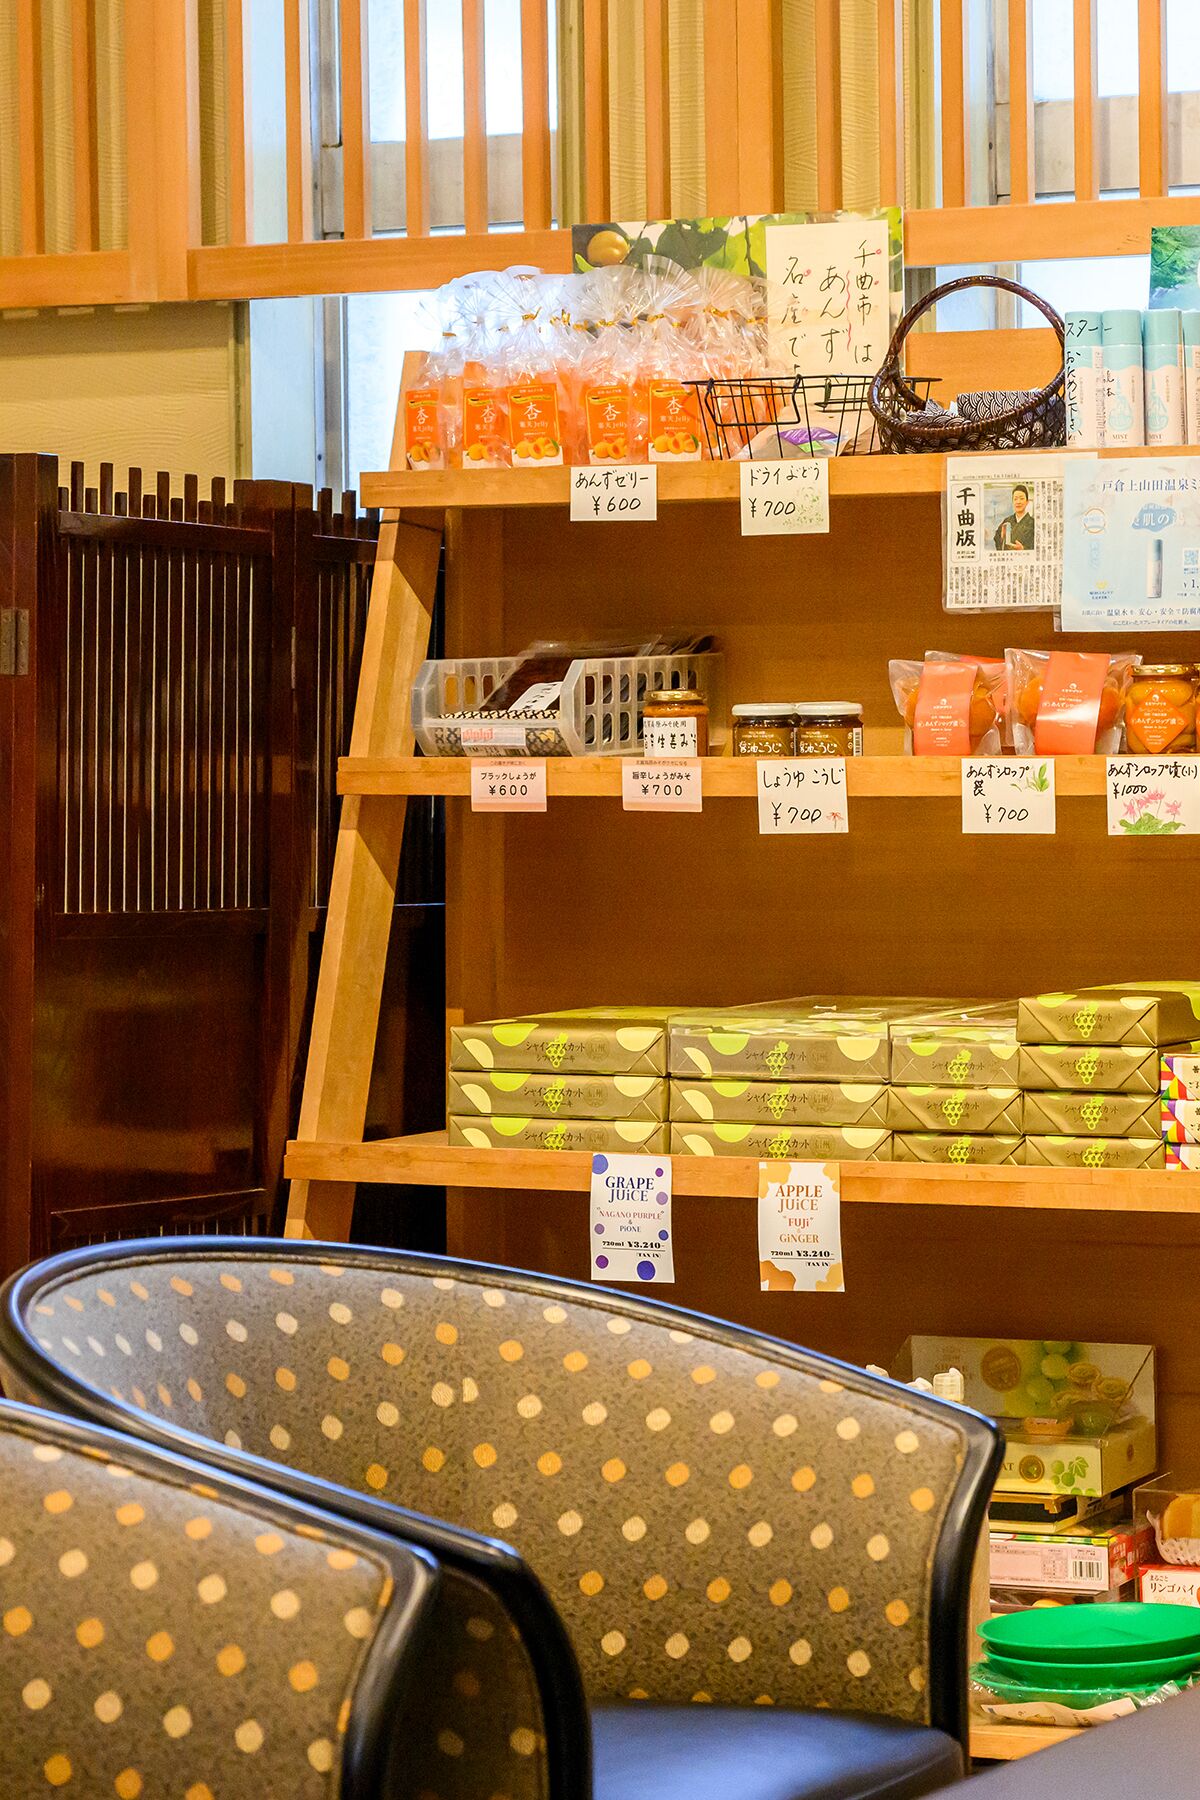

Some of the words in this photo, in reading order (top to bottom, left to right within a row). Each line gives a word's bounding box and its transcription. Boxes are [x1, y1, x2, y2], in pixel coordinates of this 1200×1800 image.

[819, 265, 848, 364] あんず
[480, 405, 496, 423] 杏
[523, 402, 543, 421] 杏
[603, 403, 621, 422] 杏
[665, 396, 683, 415] 杏
[415, 406, 429, 425] 杏
[575, 470, 649, 490] あんずゼリー
[592, 495, 641, 516] ¥600
[748, 497, 796, 518] ¥700
[956, 486, 976, 547] 千曲版
[480, 772, 537, 781] ブラックしょうが
[632, 771, 691, 781] 旨辛しょうがみそ
[966, 764, 1030, 779] あんずシロップ
[489, 784, 528, 796] ¥600
[641, 784, 683, 796] ¥700
[1113, 782, 1148, 799] ¥1000
[771, 801, 822, 827] ¥700
[984, 804, 1029, 823] ¥700
[605, 1175, 654, 1190] GRAPE
[775, 1185, 823, 1198] APPLE
[1150, 1582, 1195, 1595] リンゴパイ
